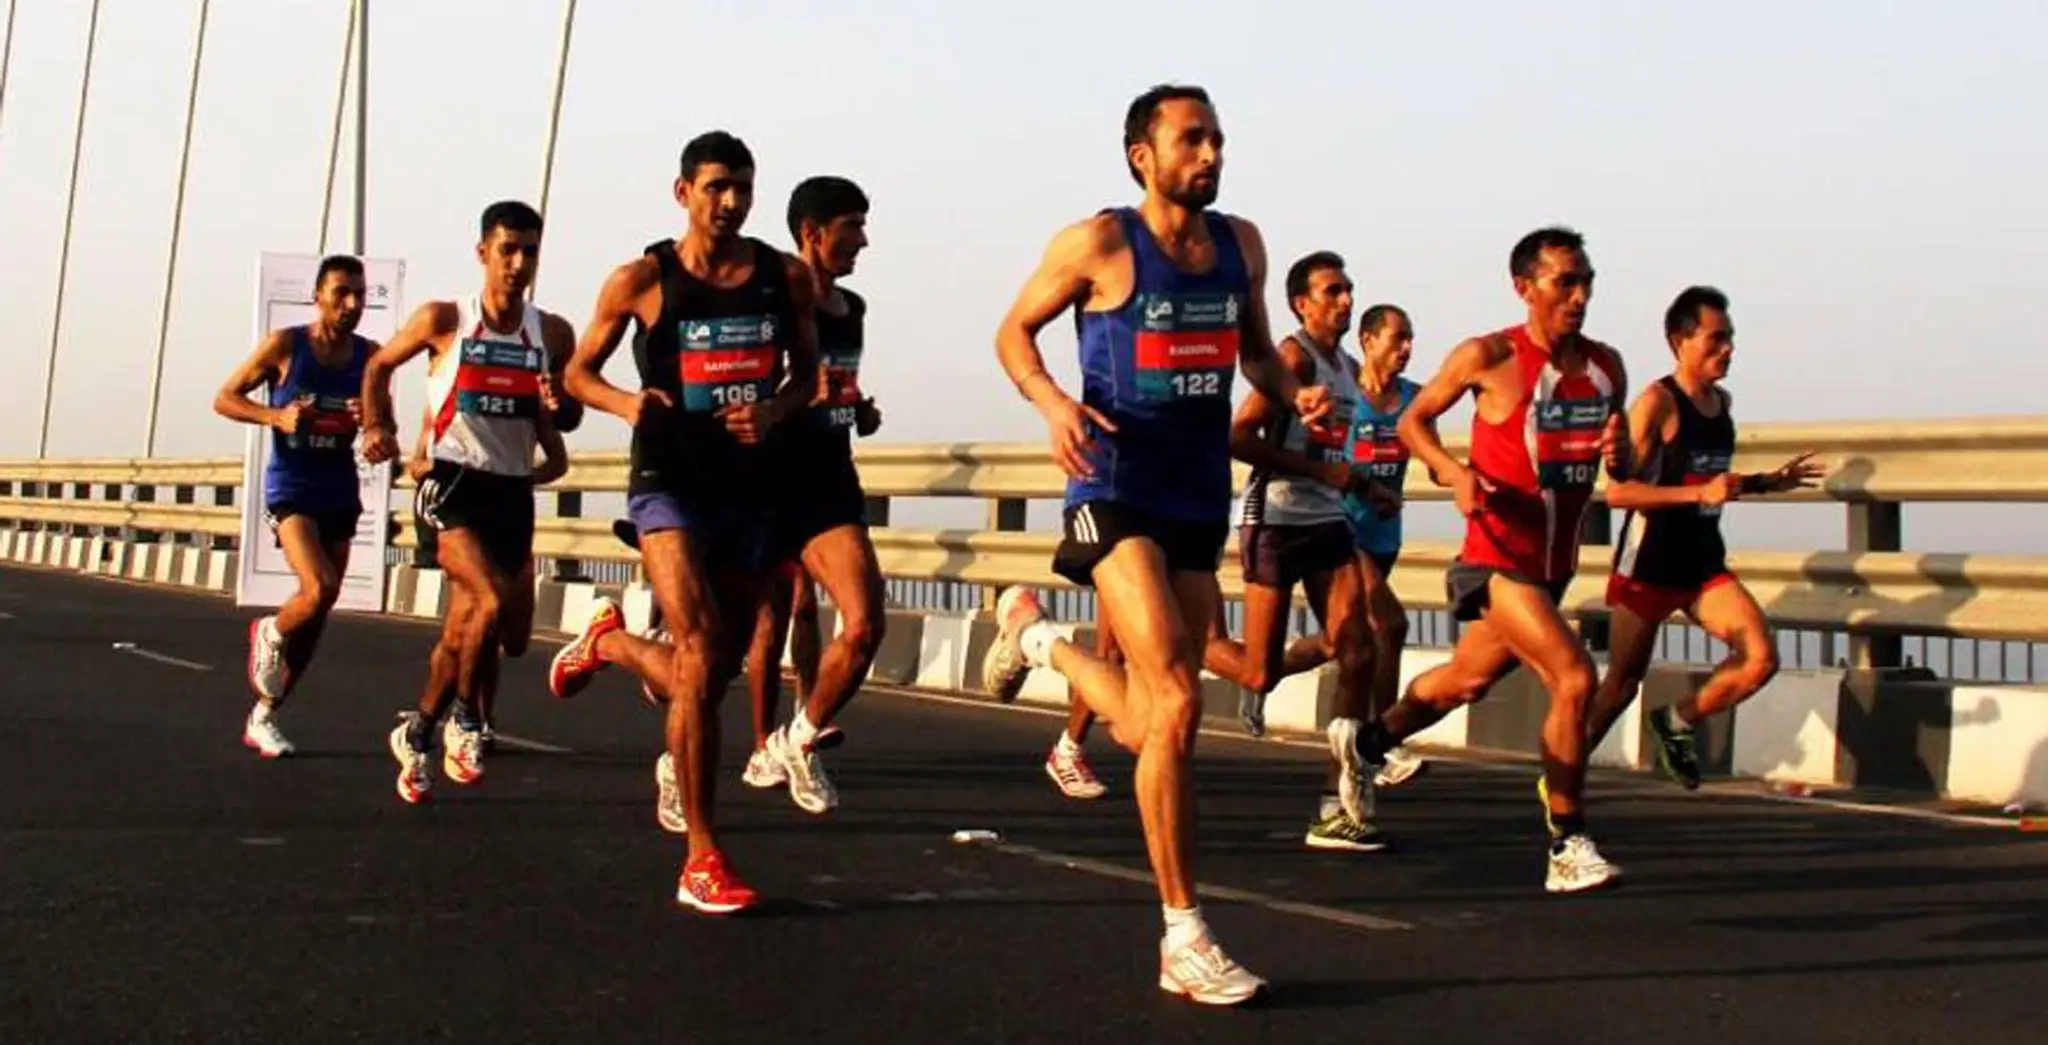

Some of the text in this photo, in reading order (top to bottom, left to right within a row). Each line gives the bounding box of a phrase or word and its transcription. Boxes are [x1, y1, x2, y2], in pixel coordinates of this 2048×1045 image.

[711, 383, 758, 406] 106
[1171, 372, 1220, 397] 122
[478, 395, 515, 414] 121
